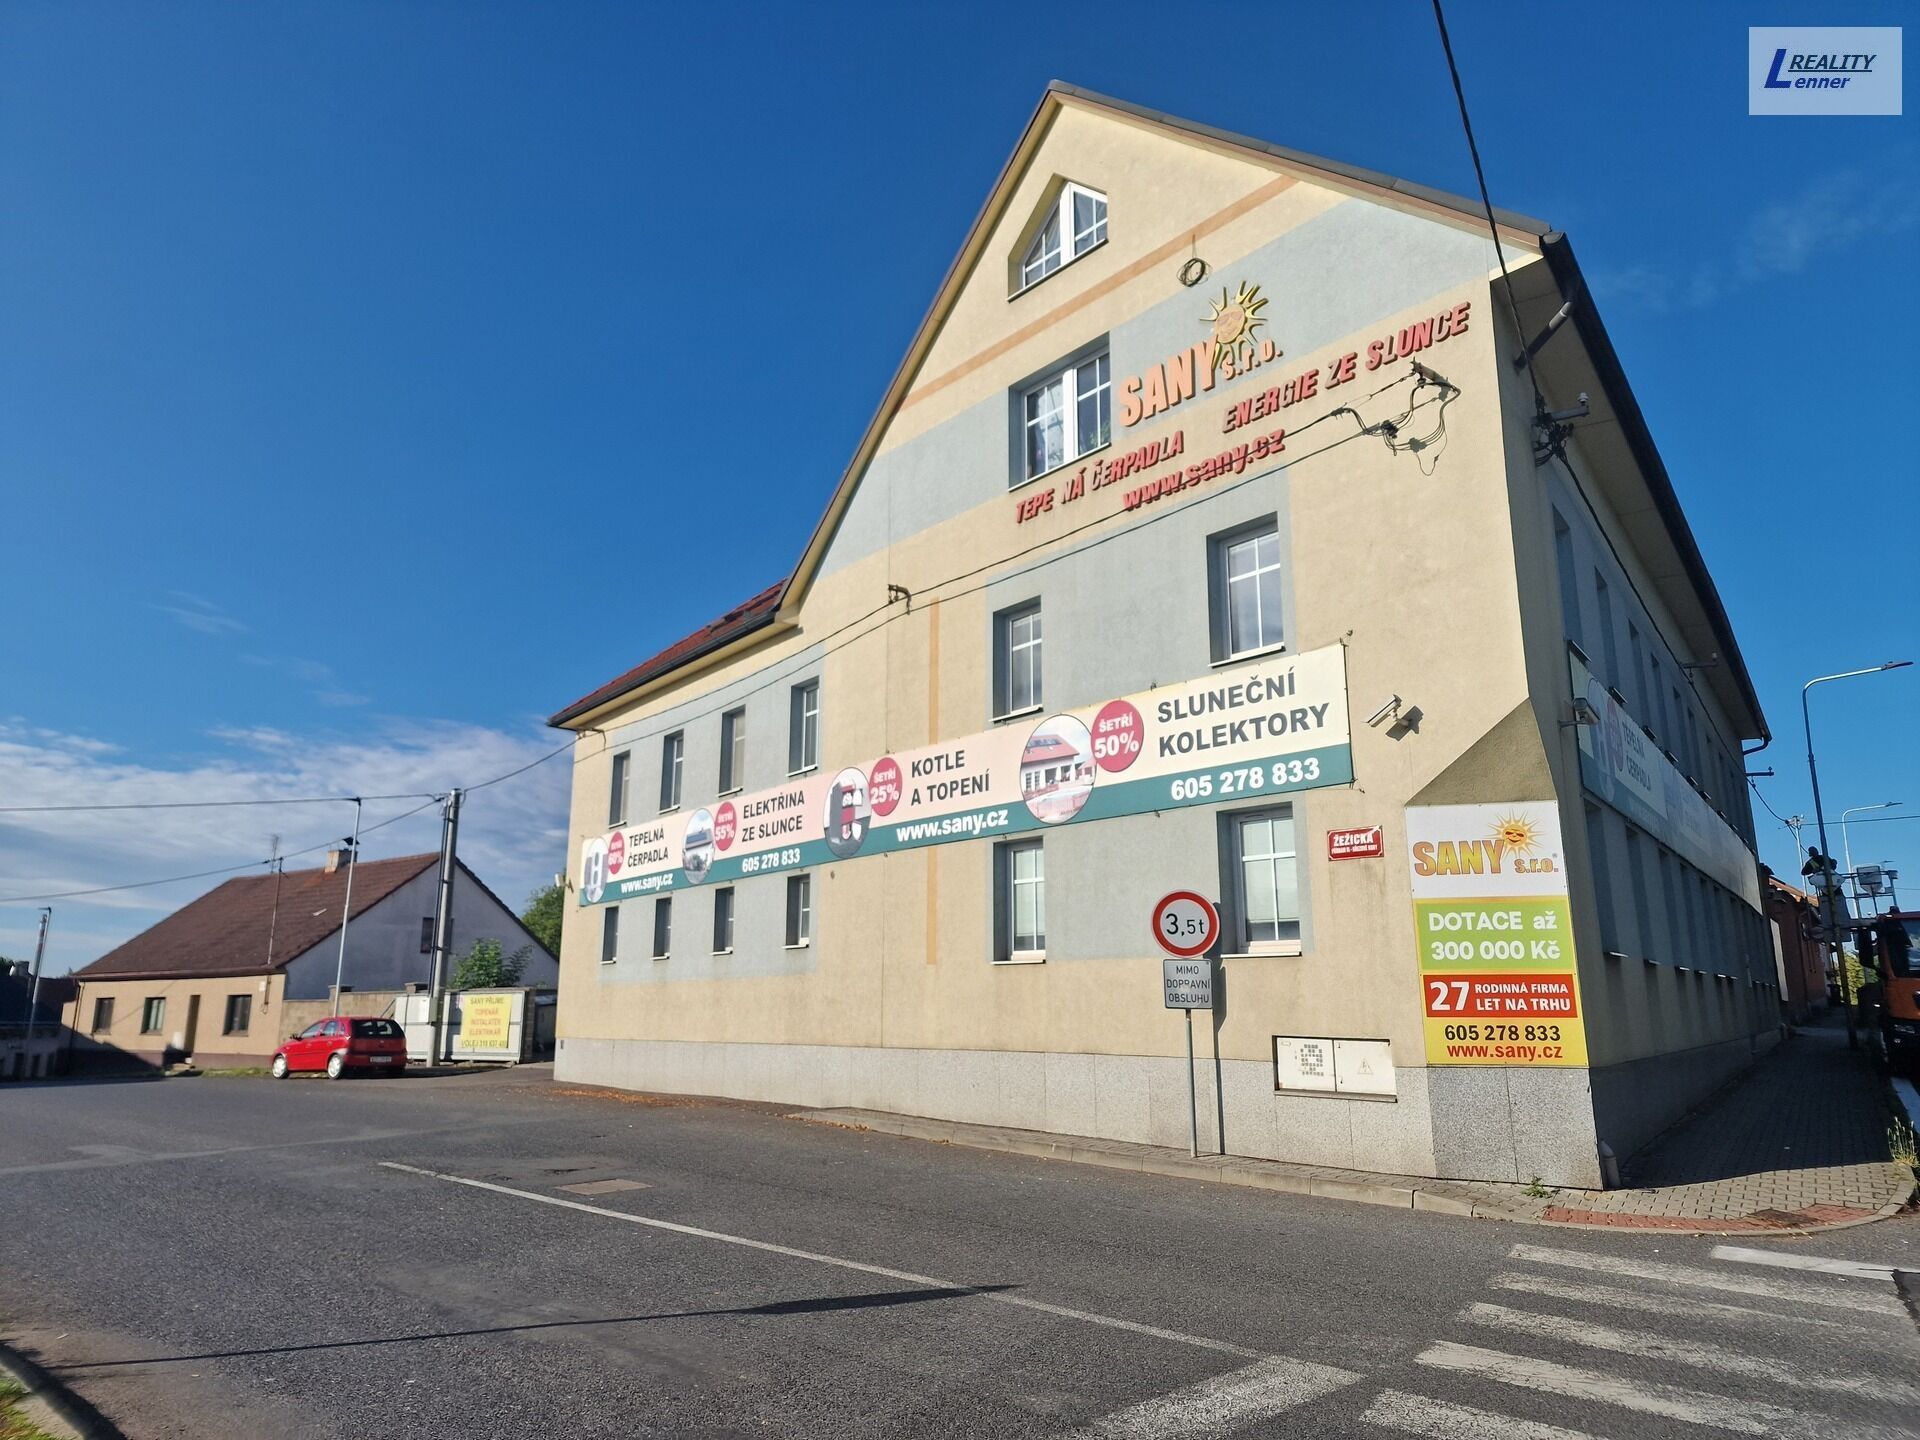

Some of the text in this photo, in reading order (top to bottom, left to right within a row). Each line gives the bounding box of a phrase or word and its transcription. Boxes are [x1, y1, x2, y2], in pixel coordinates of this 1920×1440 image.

[1222, 301, 1471, 433] ENERGIE ZE SLUNCE
[1119, 335, 1218, 427] SANY
[1091, 430, 1184, 490] ČERPADLA
[1122, 428, 1286, 511] www.sany.cz
[1157, 666, 1296, 723] SLUNEČNÍ
[1098, 711, 1133, 733] ŠETŘÍ
[1159, 702, 1330, 758] KOLEKTORY
[1094, 730, 1140, 759] 50%
[911, 750, 965, 778] KOTLE
[911, 768, 990, 806] A TOPENÍ
[1171, 756, 1321, 801] 605 278 833
[743, 790, 805, 819] ELEKTŘINA
[870, 782, 900, 805] 25%
[715, 823, 735, 840] 55%
[741, 815, 803, 842] ZE SLUNCE
[896, 809, 1009, 842] www.sany.cz
[627, 847, 669, 868] ČERPADLA
[742, 847, 801, 873] 605 278 833
[1412, 840, 1559, 876] SANY s.r.o.
[621, 873, 673, 893] www.sany.cz
[1428, 910, 1558, 931] DOTACE až
[1431, 939, 1561, 960] 300 000 Kč
[1176, 965, 1199, 975] MIMO
[1168, 993, 1210, 1003] OBSLUHU
[1429, 981, 1470, 1011] 27
[1474, 982, 1568, 994] RODINNÁ FIRMA
[1476, 998, 1571, 1011] LET NA TRHU
[1444, 1024, 1561, 1041] 605 278 833
[1446, 1045, 1563, 1062] www.sany.cz
